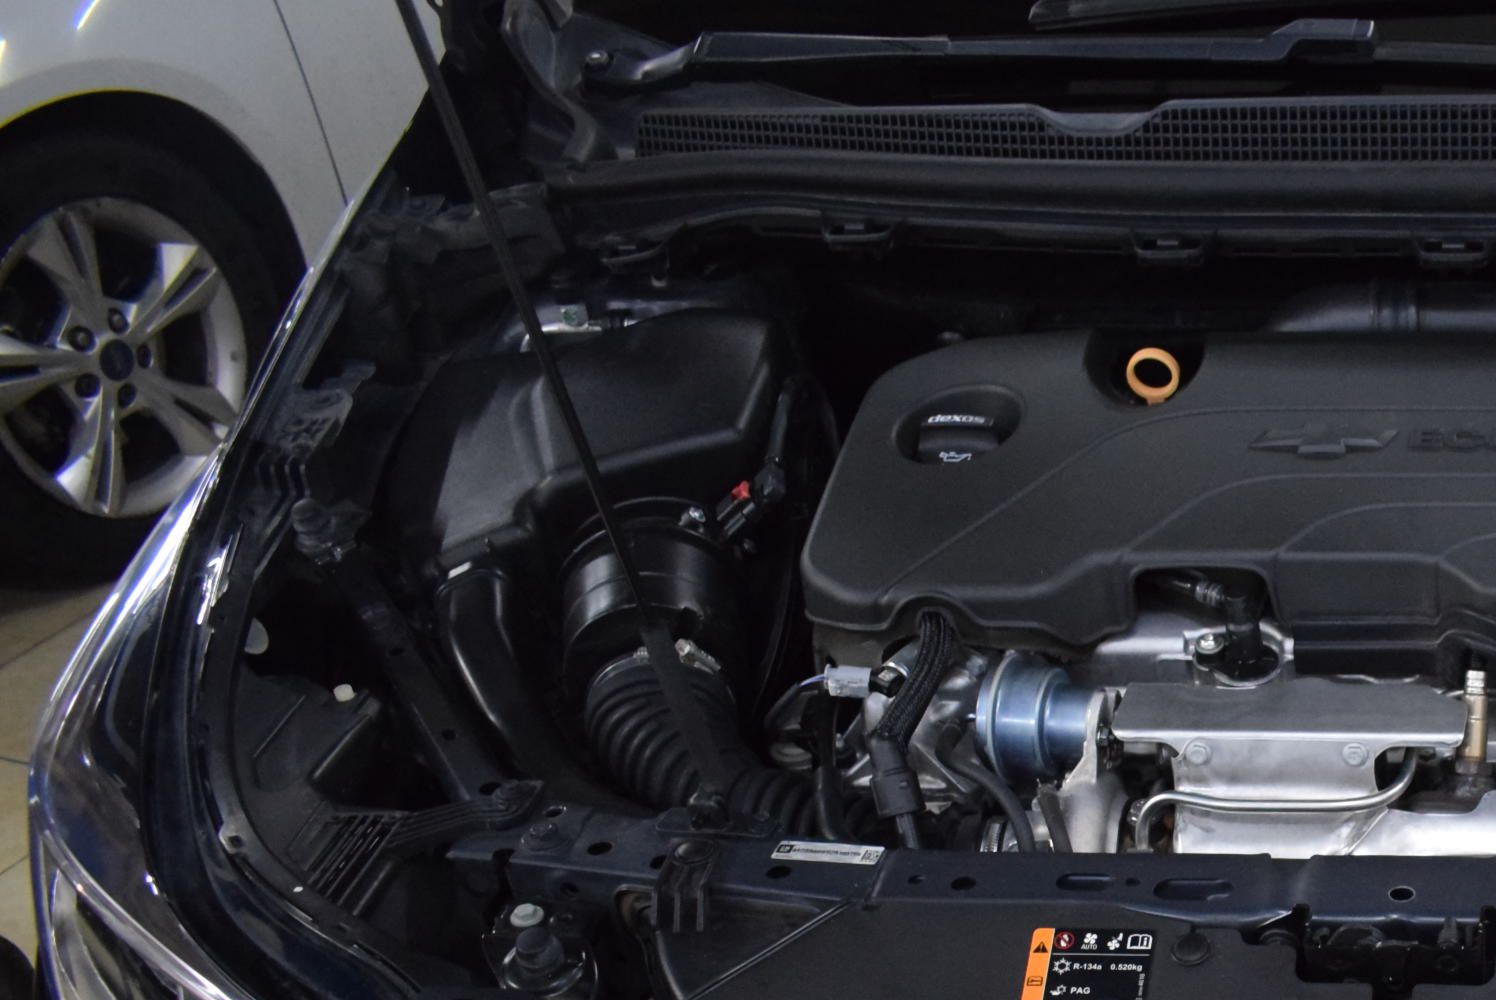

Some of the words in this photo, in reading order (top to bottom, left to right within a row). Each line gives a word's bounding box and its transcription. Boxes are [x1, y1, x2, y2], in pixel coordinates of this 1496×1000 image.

[1073, 963, 1102, 971] R-134a
[1110, 963, 1143, 972] 0.520kg
[1070, 986, 1091, 995] PAG
